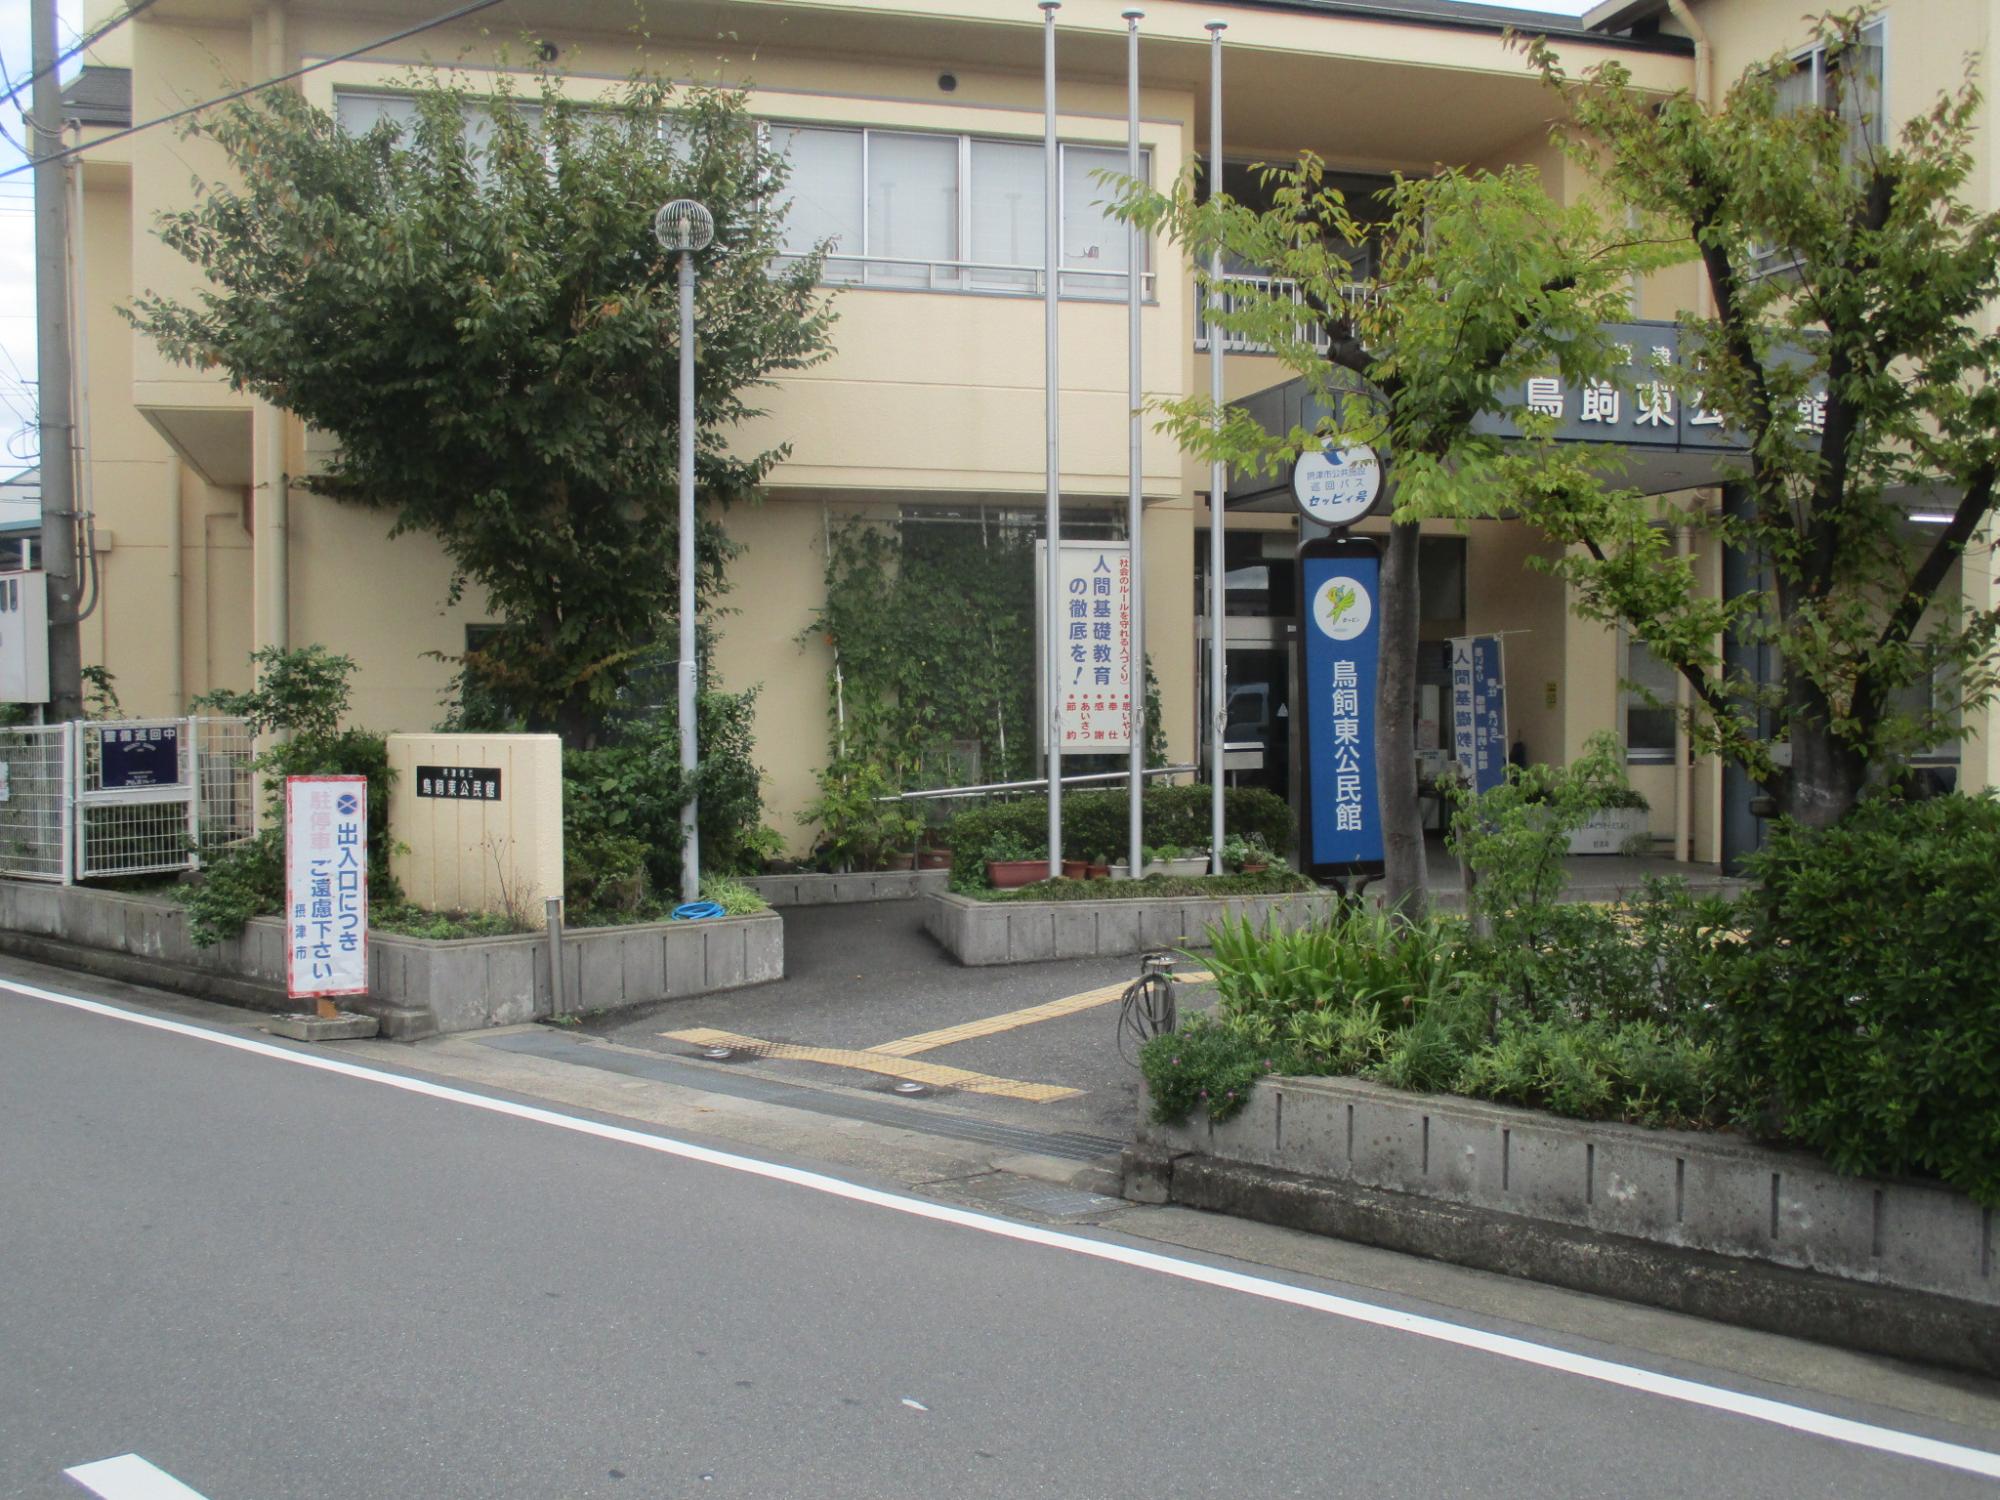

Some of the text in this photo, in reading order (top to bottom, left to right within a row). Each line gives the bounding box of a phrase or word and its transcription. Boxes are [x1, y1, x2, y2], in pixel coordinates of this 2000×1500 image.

[1093, 554, 1111, 685] 人間基礎教育
[1066, 702, 1077, 739] 節約
[1080, 702, 1091, 739] あいさつ
[1094, 702, 1105, 739] 感謝
[1108, 702, 1119, 739] 奉仕
[1333, 660, 1362, 831] 鳥飼東公民館
[423, 778, 496, 798] 鳥飼東公民館
[310, 790, 333, 979] 駐停車 ご遠慮下さい
[337, 821, 359, 952] 出入口につき
[295, 903, 307, 960] 摂津市
